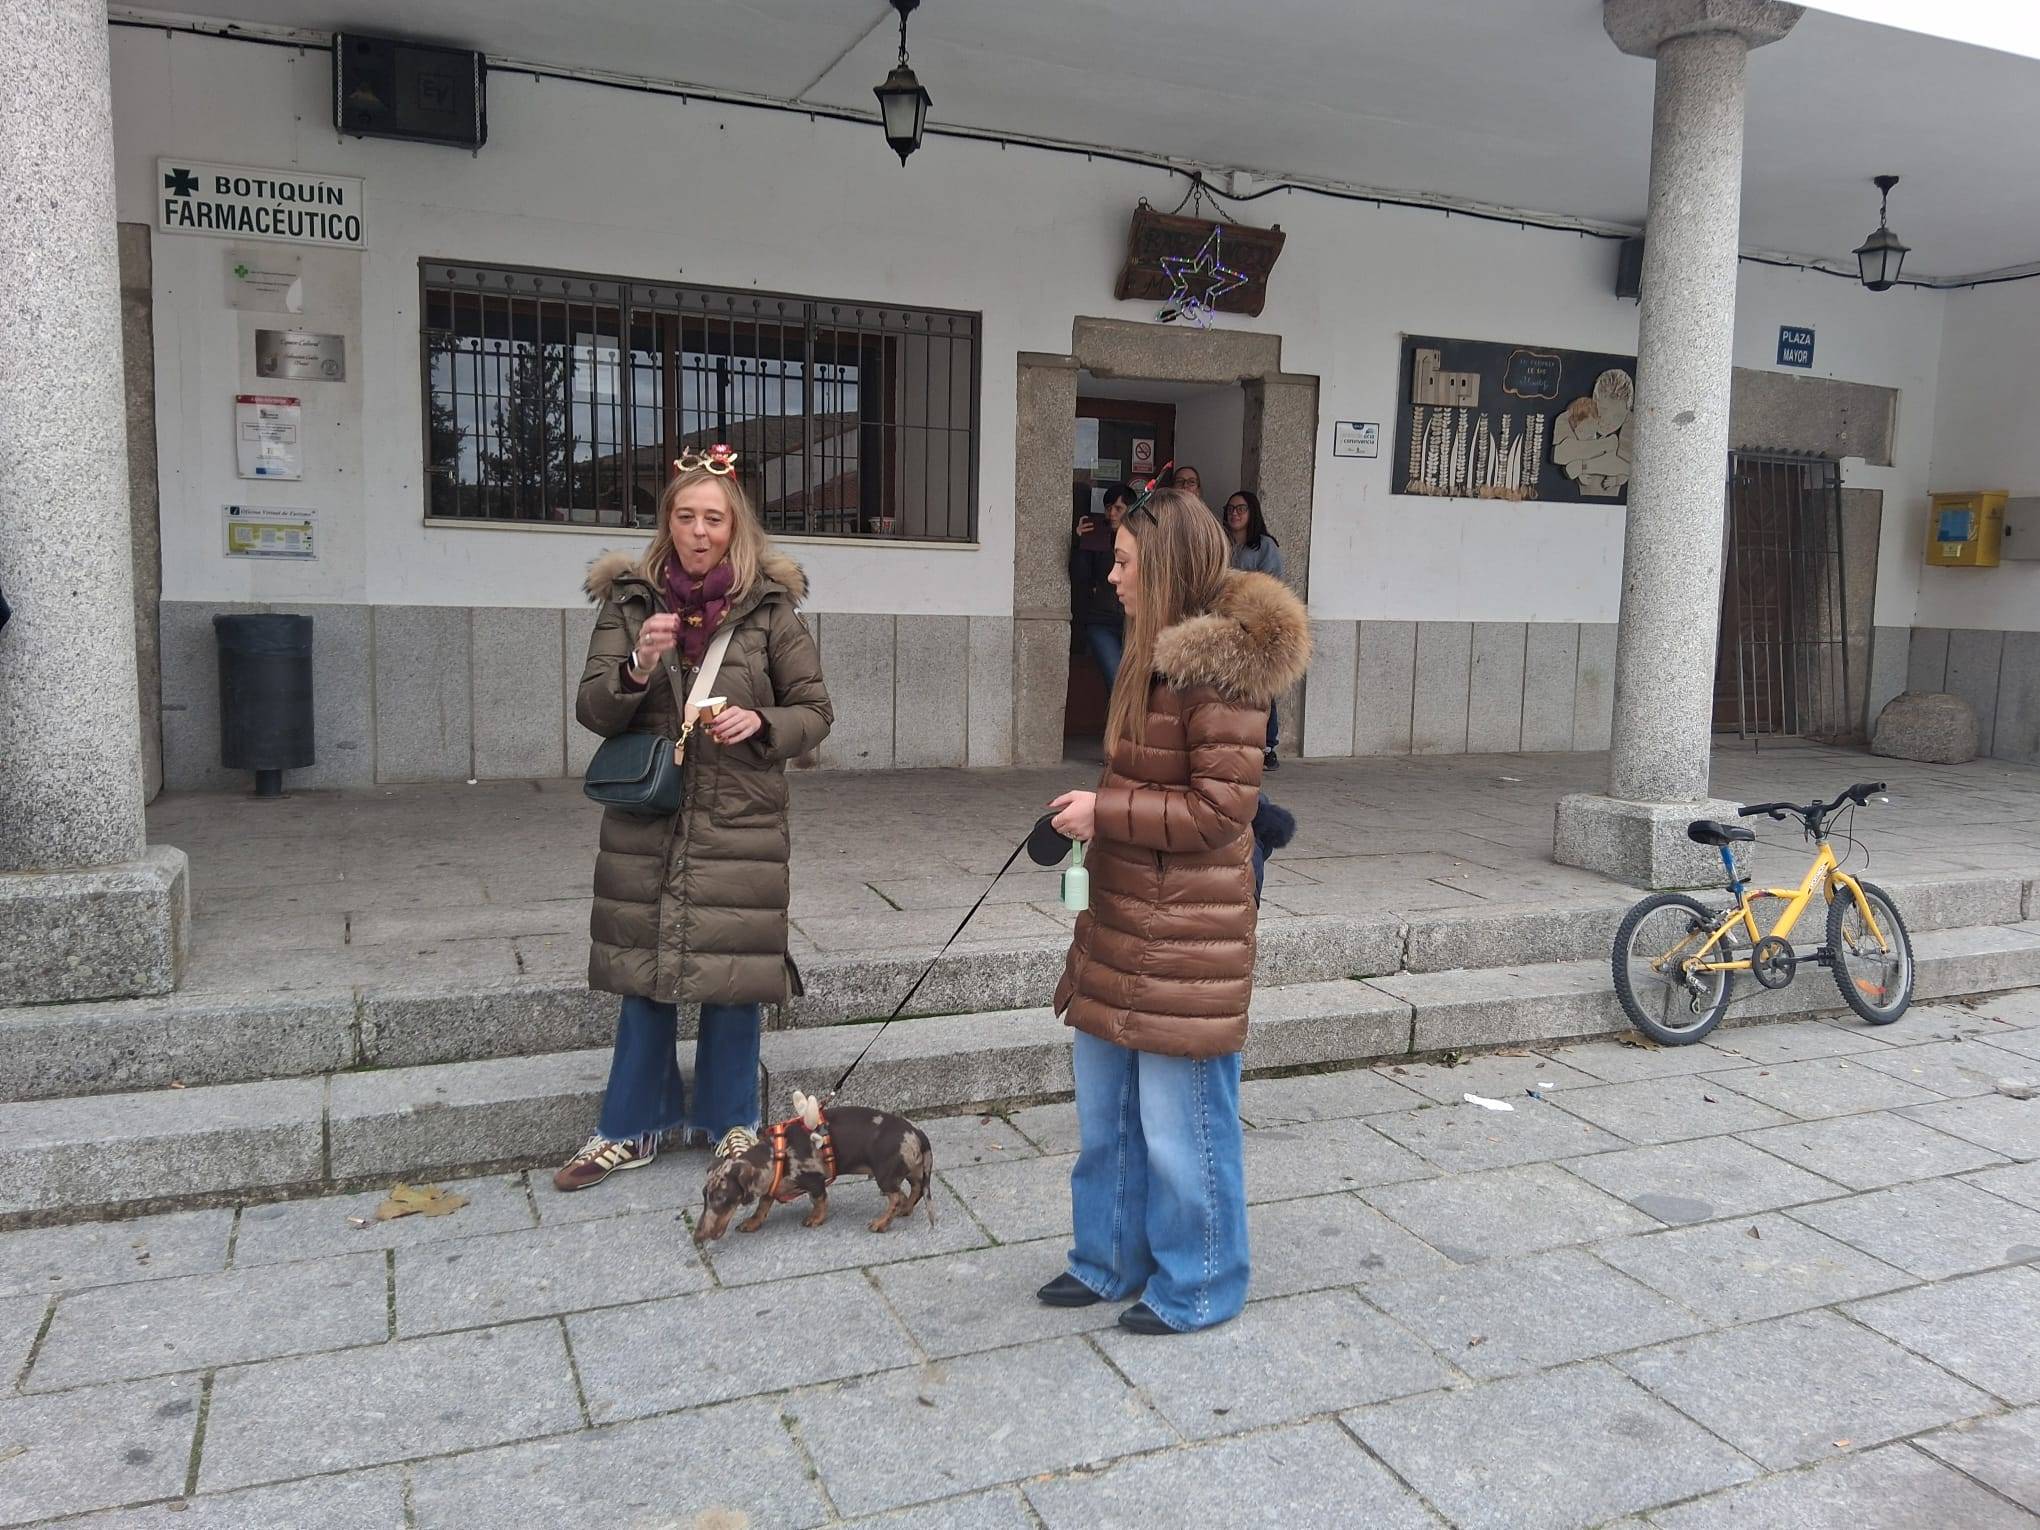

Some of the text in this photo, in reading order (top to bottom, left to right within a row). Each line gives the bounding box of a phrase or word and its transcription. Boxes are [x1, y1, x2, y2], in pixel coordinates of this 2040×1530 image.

[215, 176, 344, 206] BOTIQUÍN
[164, 198, 361, 242] FARMACÉUTICO
[1782, 330, 1811, 345] PLAZA
[1782, 347, 1808, 364] MAYOR
